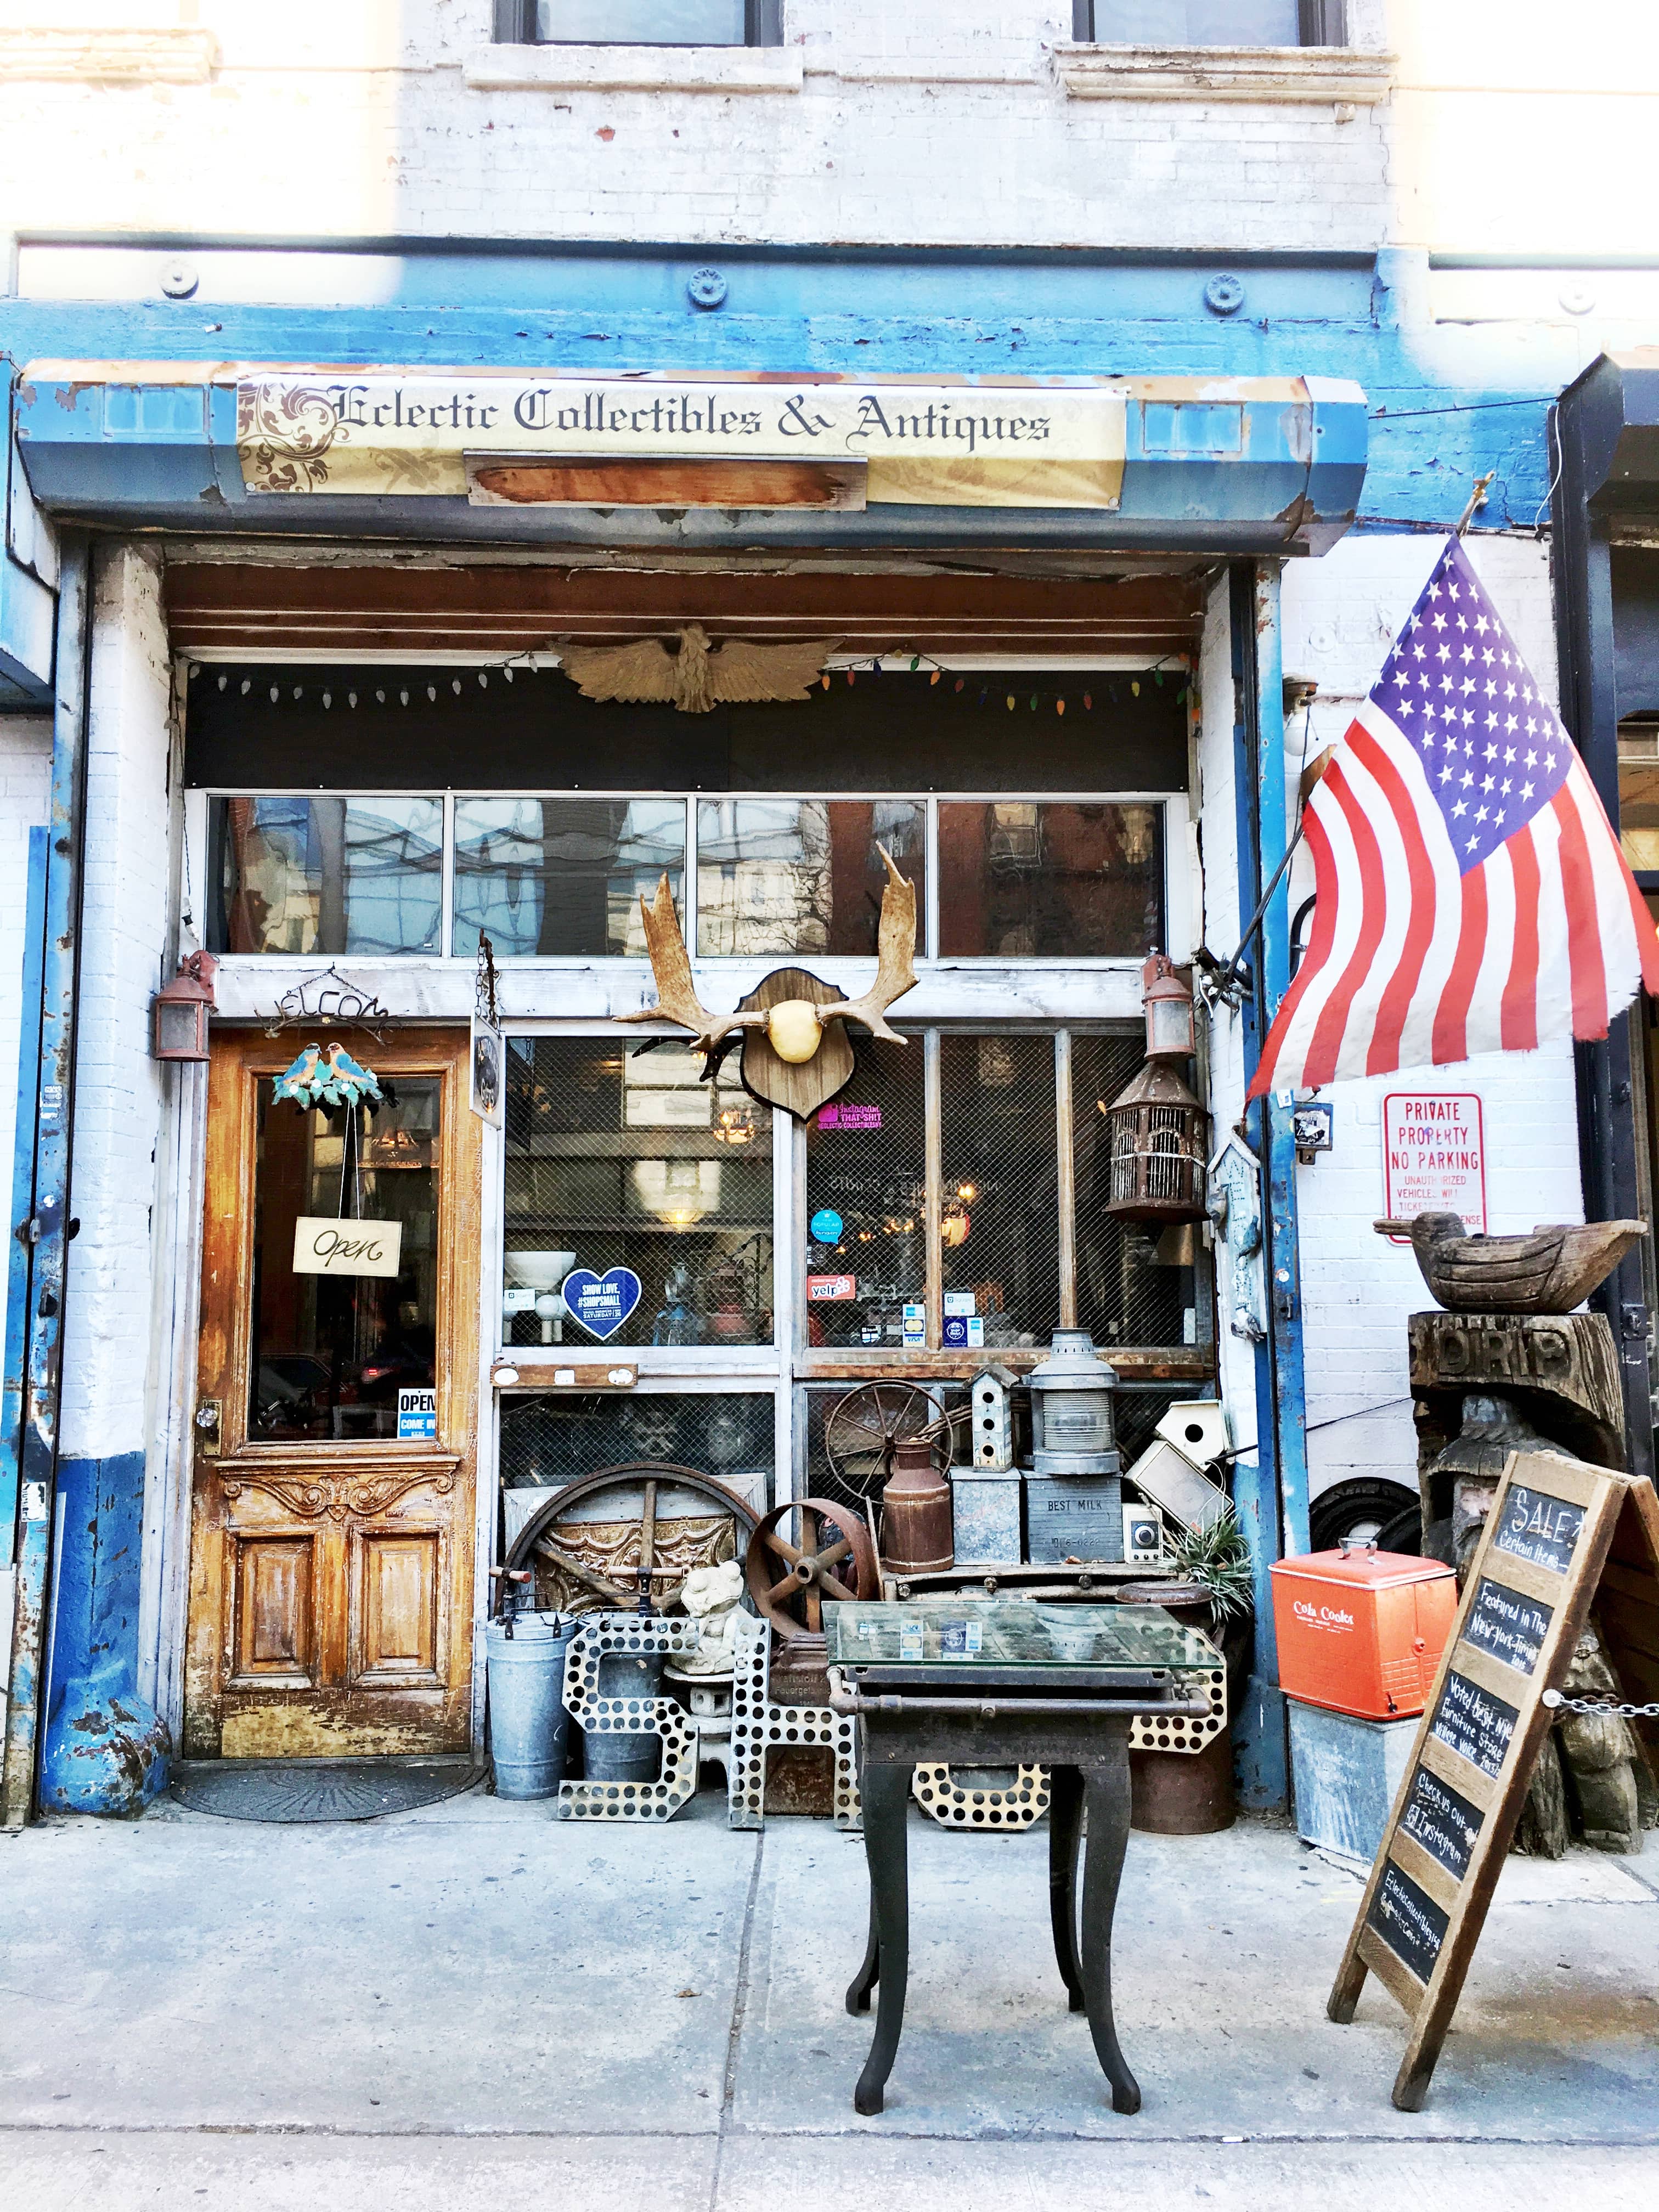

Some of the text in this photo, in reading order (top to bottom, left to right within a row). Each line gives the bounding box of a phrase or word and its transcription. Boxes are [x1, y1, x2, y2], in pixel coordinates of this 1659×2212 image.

[328, 385, 1051, 453] Eclectic Collectibles & Antiques
[840, 1114, 860, 1122] THAT
[1405, 1102, 1460, 1120] PRIVATE
[1399, 1127, 1468, 1145] PROPERTY
[1392, 1152, 1478, 1170] NO PARKING
[1404, 1175, 1466, 1186] UNAUTHRIZED
[313, 1230, 383, 1267] Open
[582, 1283, 620, 1295] SHOW LOVE,
[812, 1285, 838, 1297] yelp
[577, 1295, 621, 1308] #SHOPSMALL
[400, 1395, 436, 1411] OPEN
[401, 1419, 436, 1430] COME IN
[1048, 1499, 1102, 1511] BEST MILK
[1511, 1489, 1572, 1543] SALE
[1499, 1528, 1559, 1568] Certain items
[1293, 1601, 1317, 1617] Cola
[1321, 1606, 1354, 1625] Cooler
[1481, 1582, 1547, 1636] Featured in The
[1471, 1612, 1494, 1639] New
[1451, 1675, 1475, 1710] Voted
